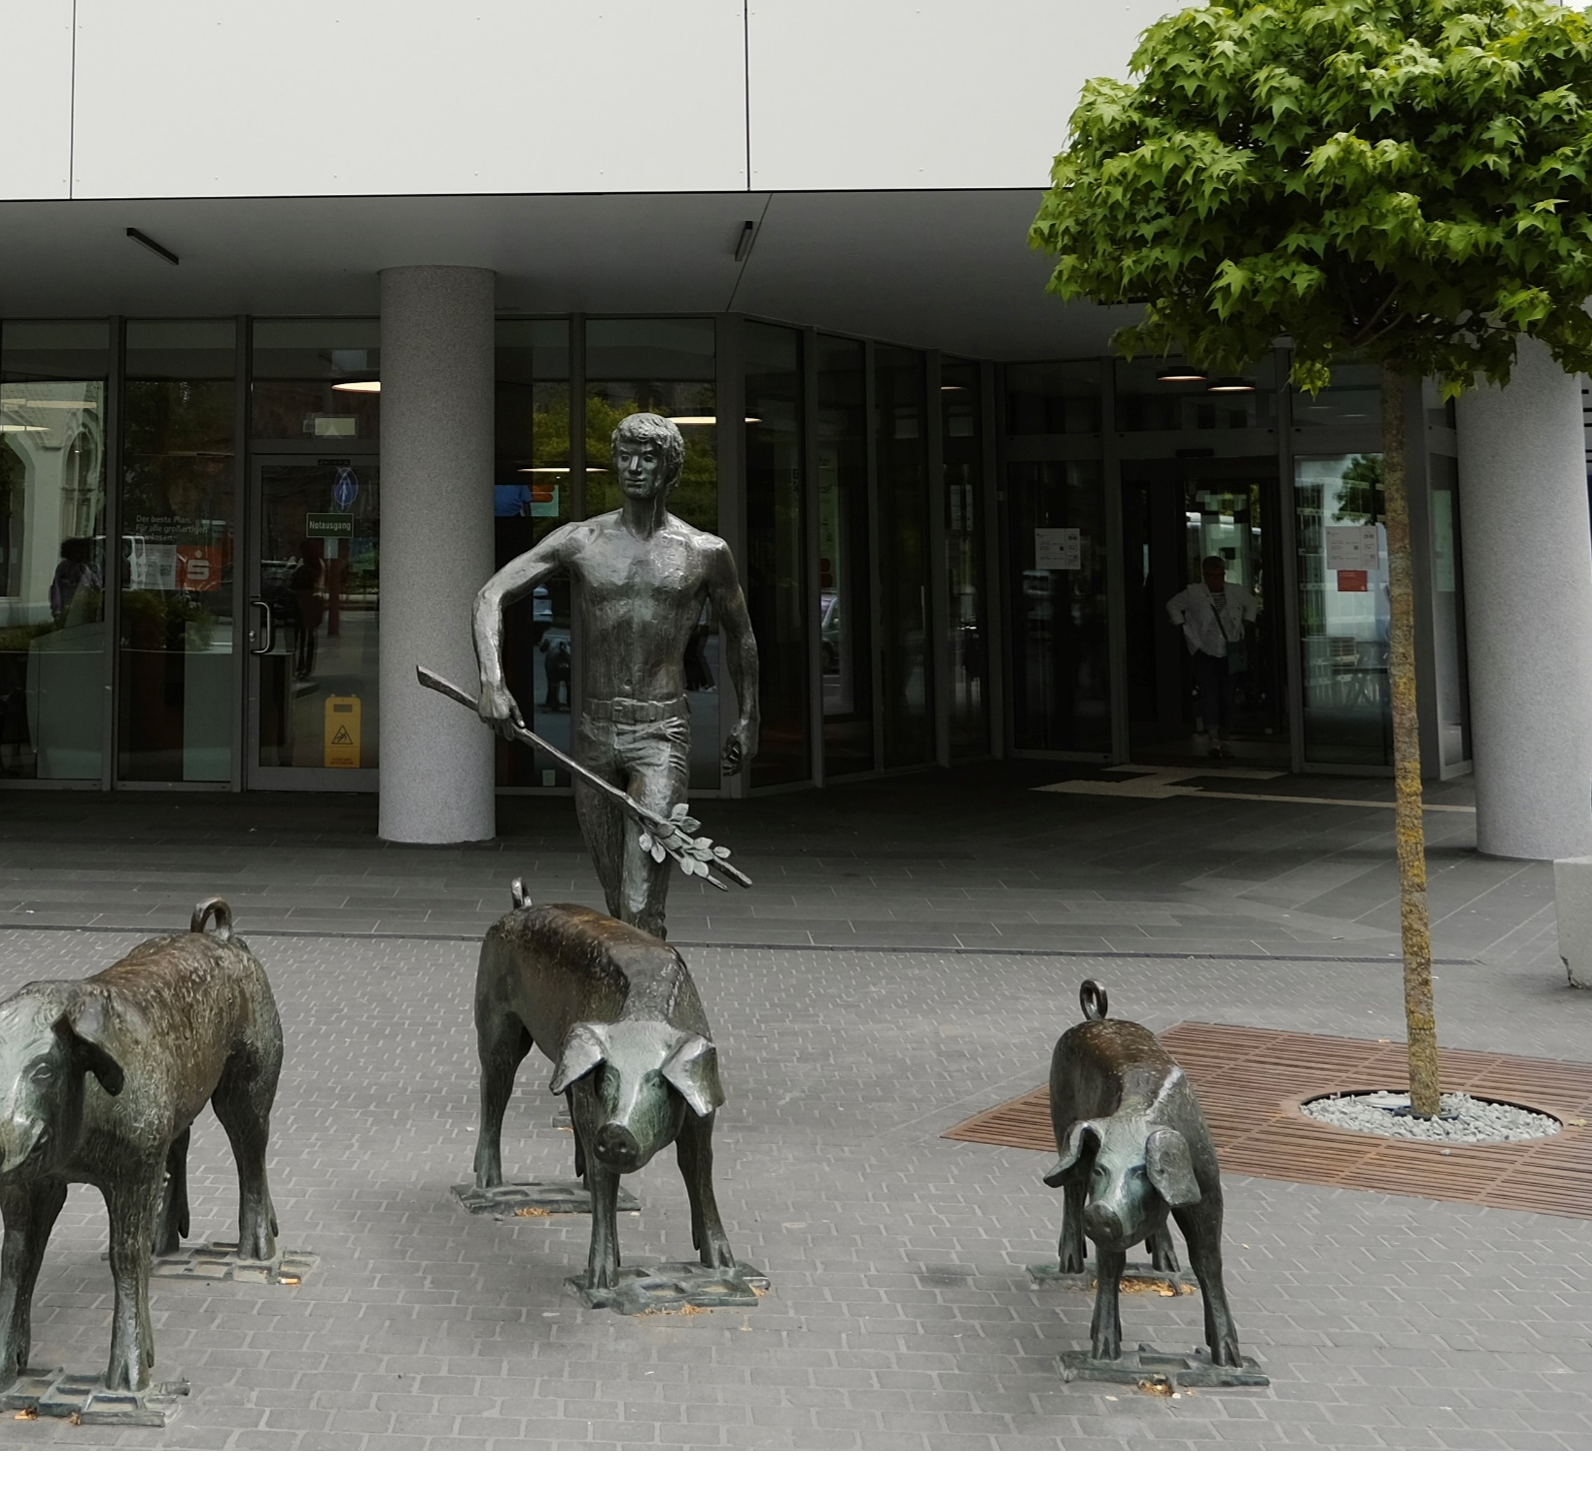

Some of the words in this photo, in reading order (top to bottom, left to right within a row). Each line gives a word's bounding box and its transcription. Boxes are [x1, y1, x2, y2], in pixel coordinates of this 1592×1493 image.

[136, 514, 150, 523] Der
[151, 514, 172, 523] beste
[163, 524, 208, 535] großartigen
[309, 520, 352, 532] Notausgang
